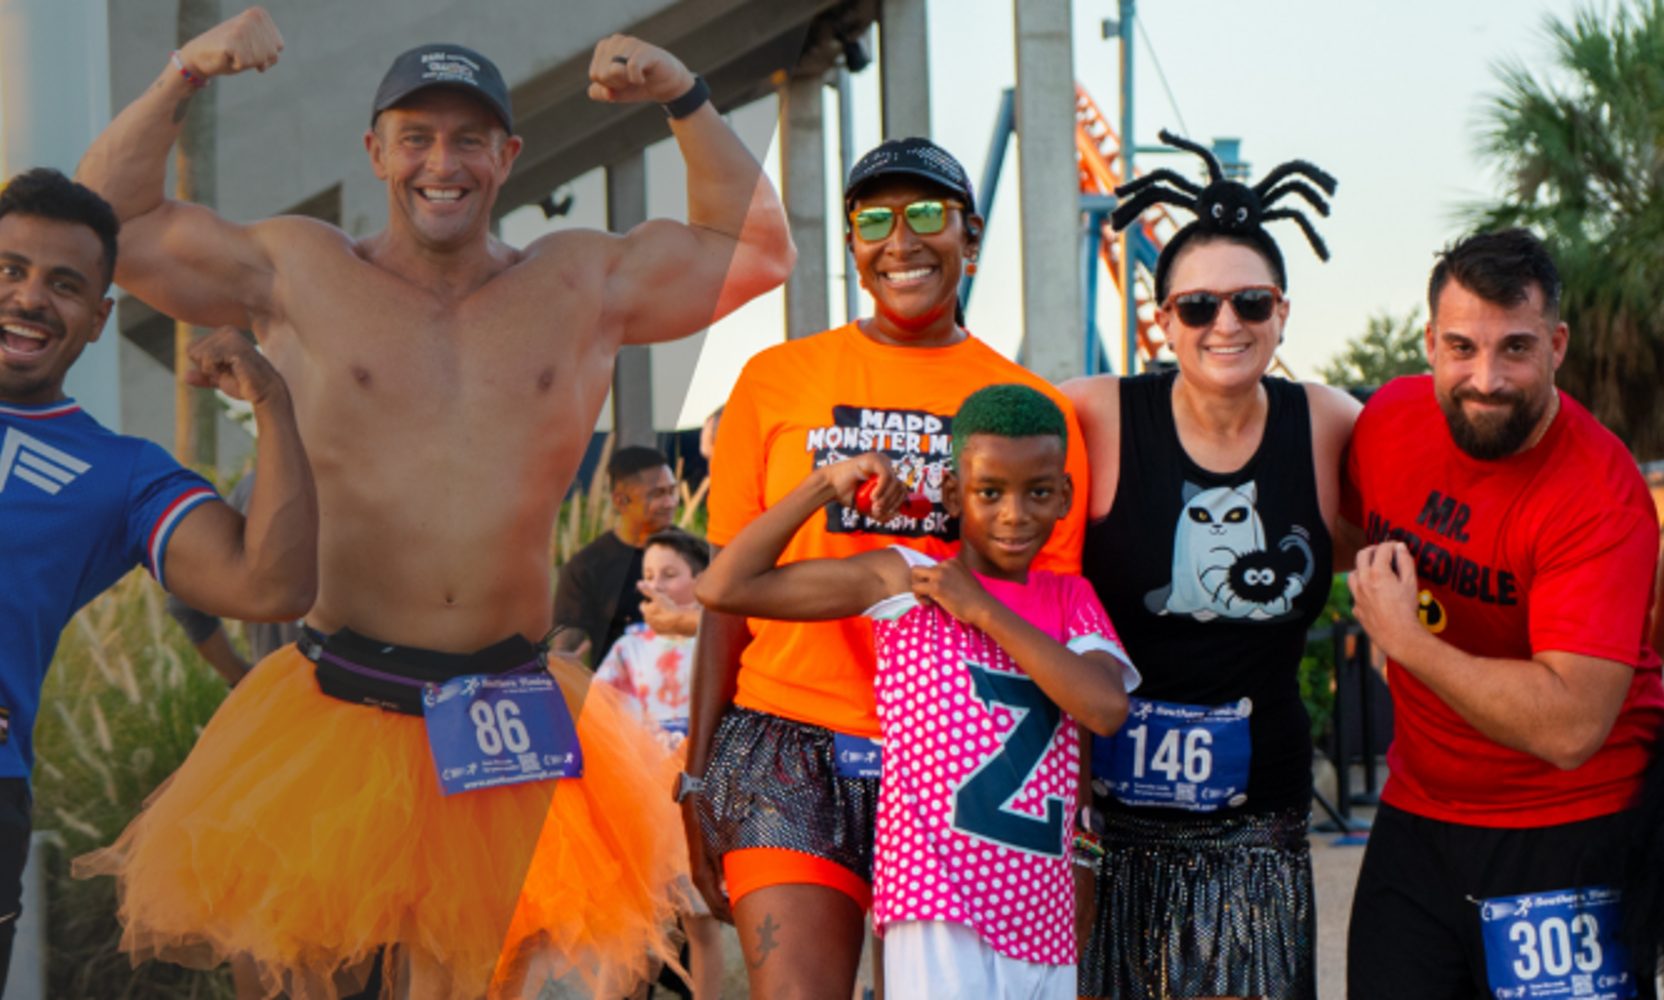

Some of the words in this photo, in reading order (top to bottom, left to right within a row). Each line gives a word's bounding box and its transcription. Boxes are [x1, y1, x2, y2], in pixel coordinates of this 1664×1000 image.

[806, 426, 921, 453] MONSTER
[861, 408, 943, 434] MADD
[1416, 490, 1471, 544] MR.
[469, 699, 531, 756] 86
[1126, 724, 1214, 783] 146
[1508, 913, 1603, 981] 303
